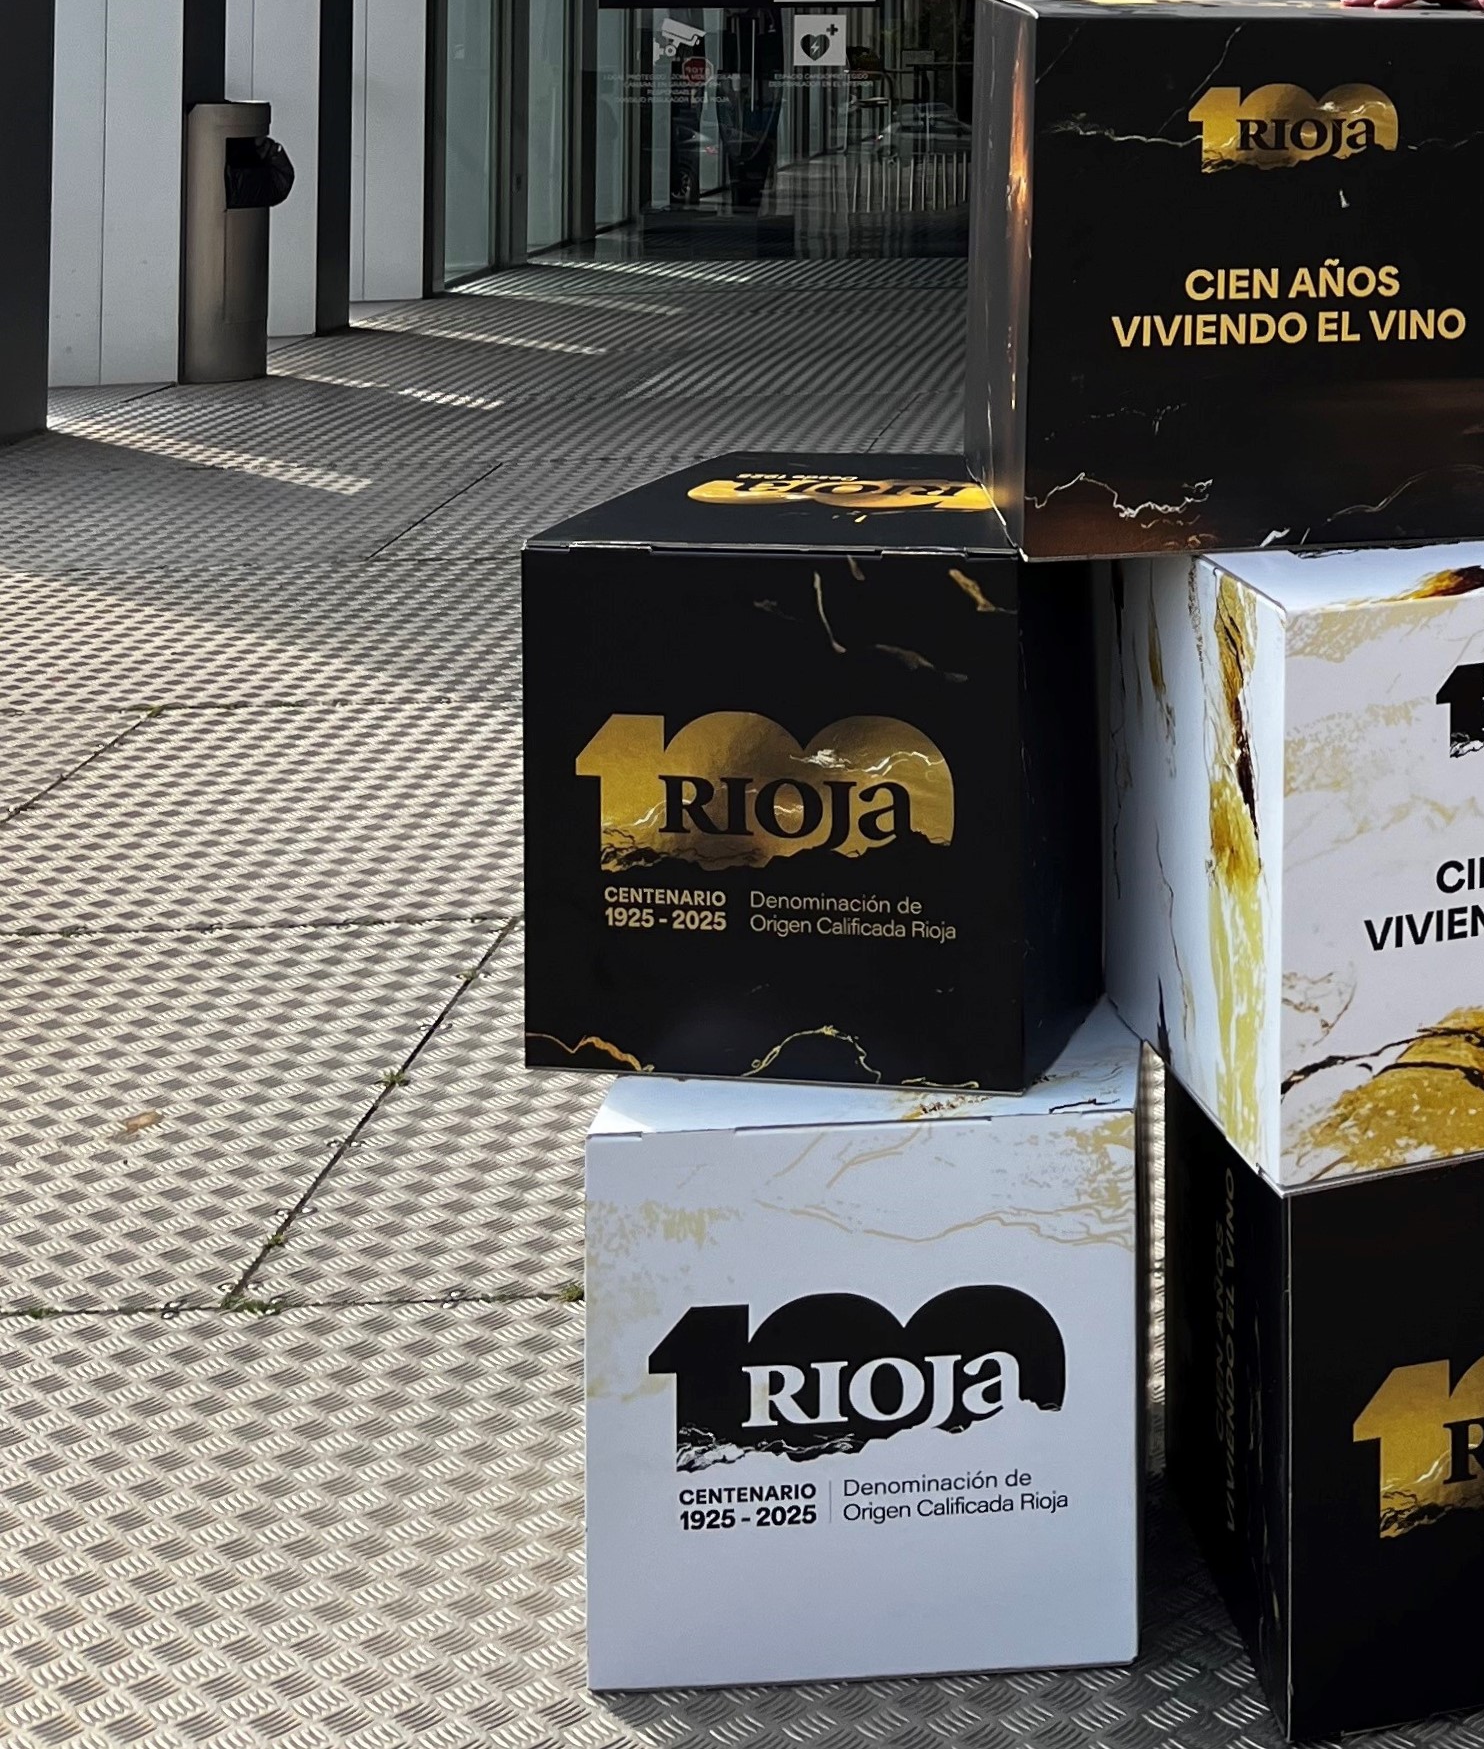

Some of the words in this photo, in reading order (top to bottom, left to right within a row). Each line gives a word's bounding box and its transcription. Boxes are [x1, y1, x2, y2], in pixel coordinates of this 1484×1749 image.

[1185, 267, 1279, 301] CIEN
[1288, 258, 1400, 299] AÑOS
[1111, 313, 1307, 348] VIVIENDO
[1318, 310, 1361, 343] EL
[1369, 307, 1467, 342] VINO
[604, 887, 727, 907] CENTENARIO
[750, 891, 891, 914] Denominación
[897, 895, 923, 915] de
[750, 915, 812, 938] Origen
[817, 916, 906, 938] Calificada
[912, 920, 957, 942] Rioja
[1225, 1167, 1235, 1269] VINO
[1226, 1283, 1235, 1329] EL
[1225, 1335, 1235, 1532] VIVIENDO
[679, 1484, 816, 1506] CENTENARIO
[843, 1471, 998, 1498] Denominación
[1005, 1470, 1032, 1489] de
[843, 1501, 912, 1526] Origen
[917, 1495, 1014, 1518] Calificada
[1020, 1490, 1069, 1517] Rioja
